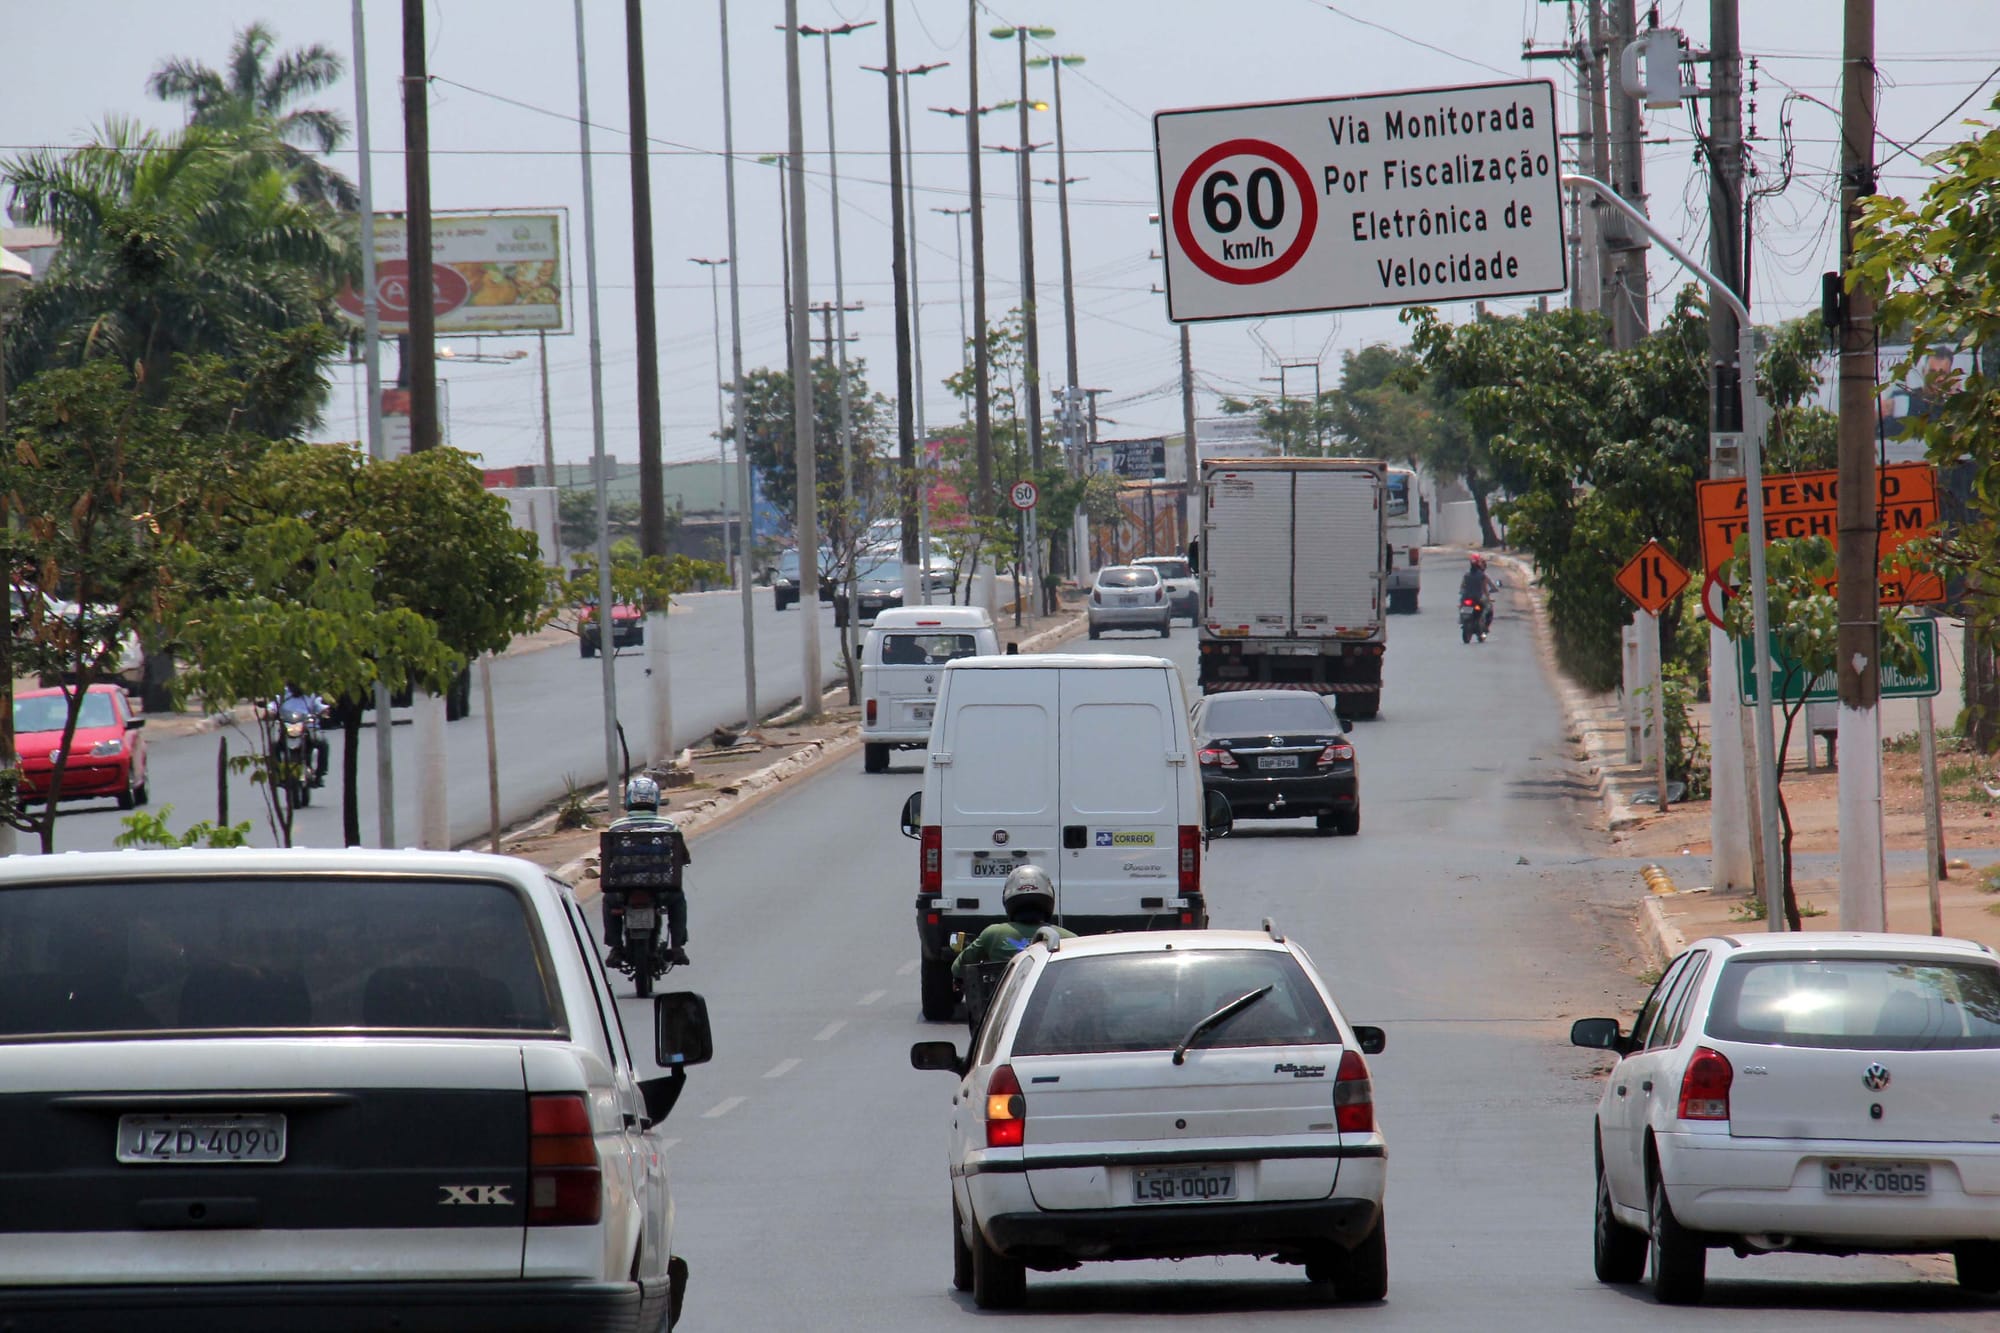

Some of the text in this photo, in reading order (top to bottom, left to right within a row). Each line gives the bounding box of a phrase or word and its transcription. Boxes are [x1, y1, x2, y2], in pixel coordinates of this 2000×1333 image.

[1328, 101, 1535, 146] Via Monitorada
[1324, 149, 1549, 196] Por Fiscalização
[1202, 167, 1285, 234] 60
[1352, 199, 1534, 242] Eletrônica de
[1222, 236, 1274, 262] km/h
[1377, 250, 1519, 289] Velocidade
[1015, 487, 1032, 500] 60
[1735, 477, 1900, 510] ATENO
